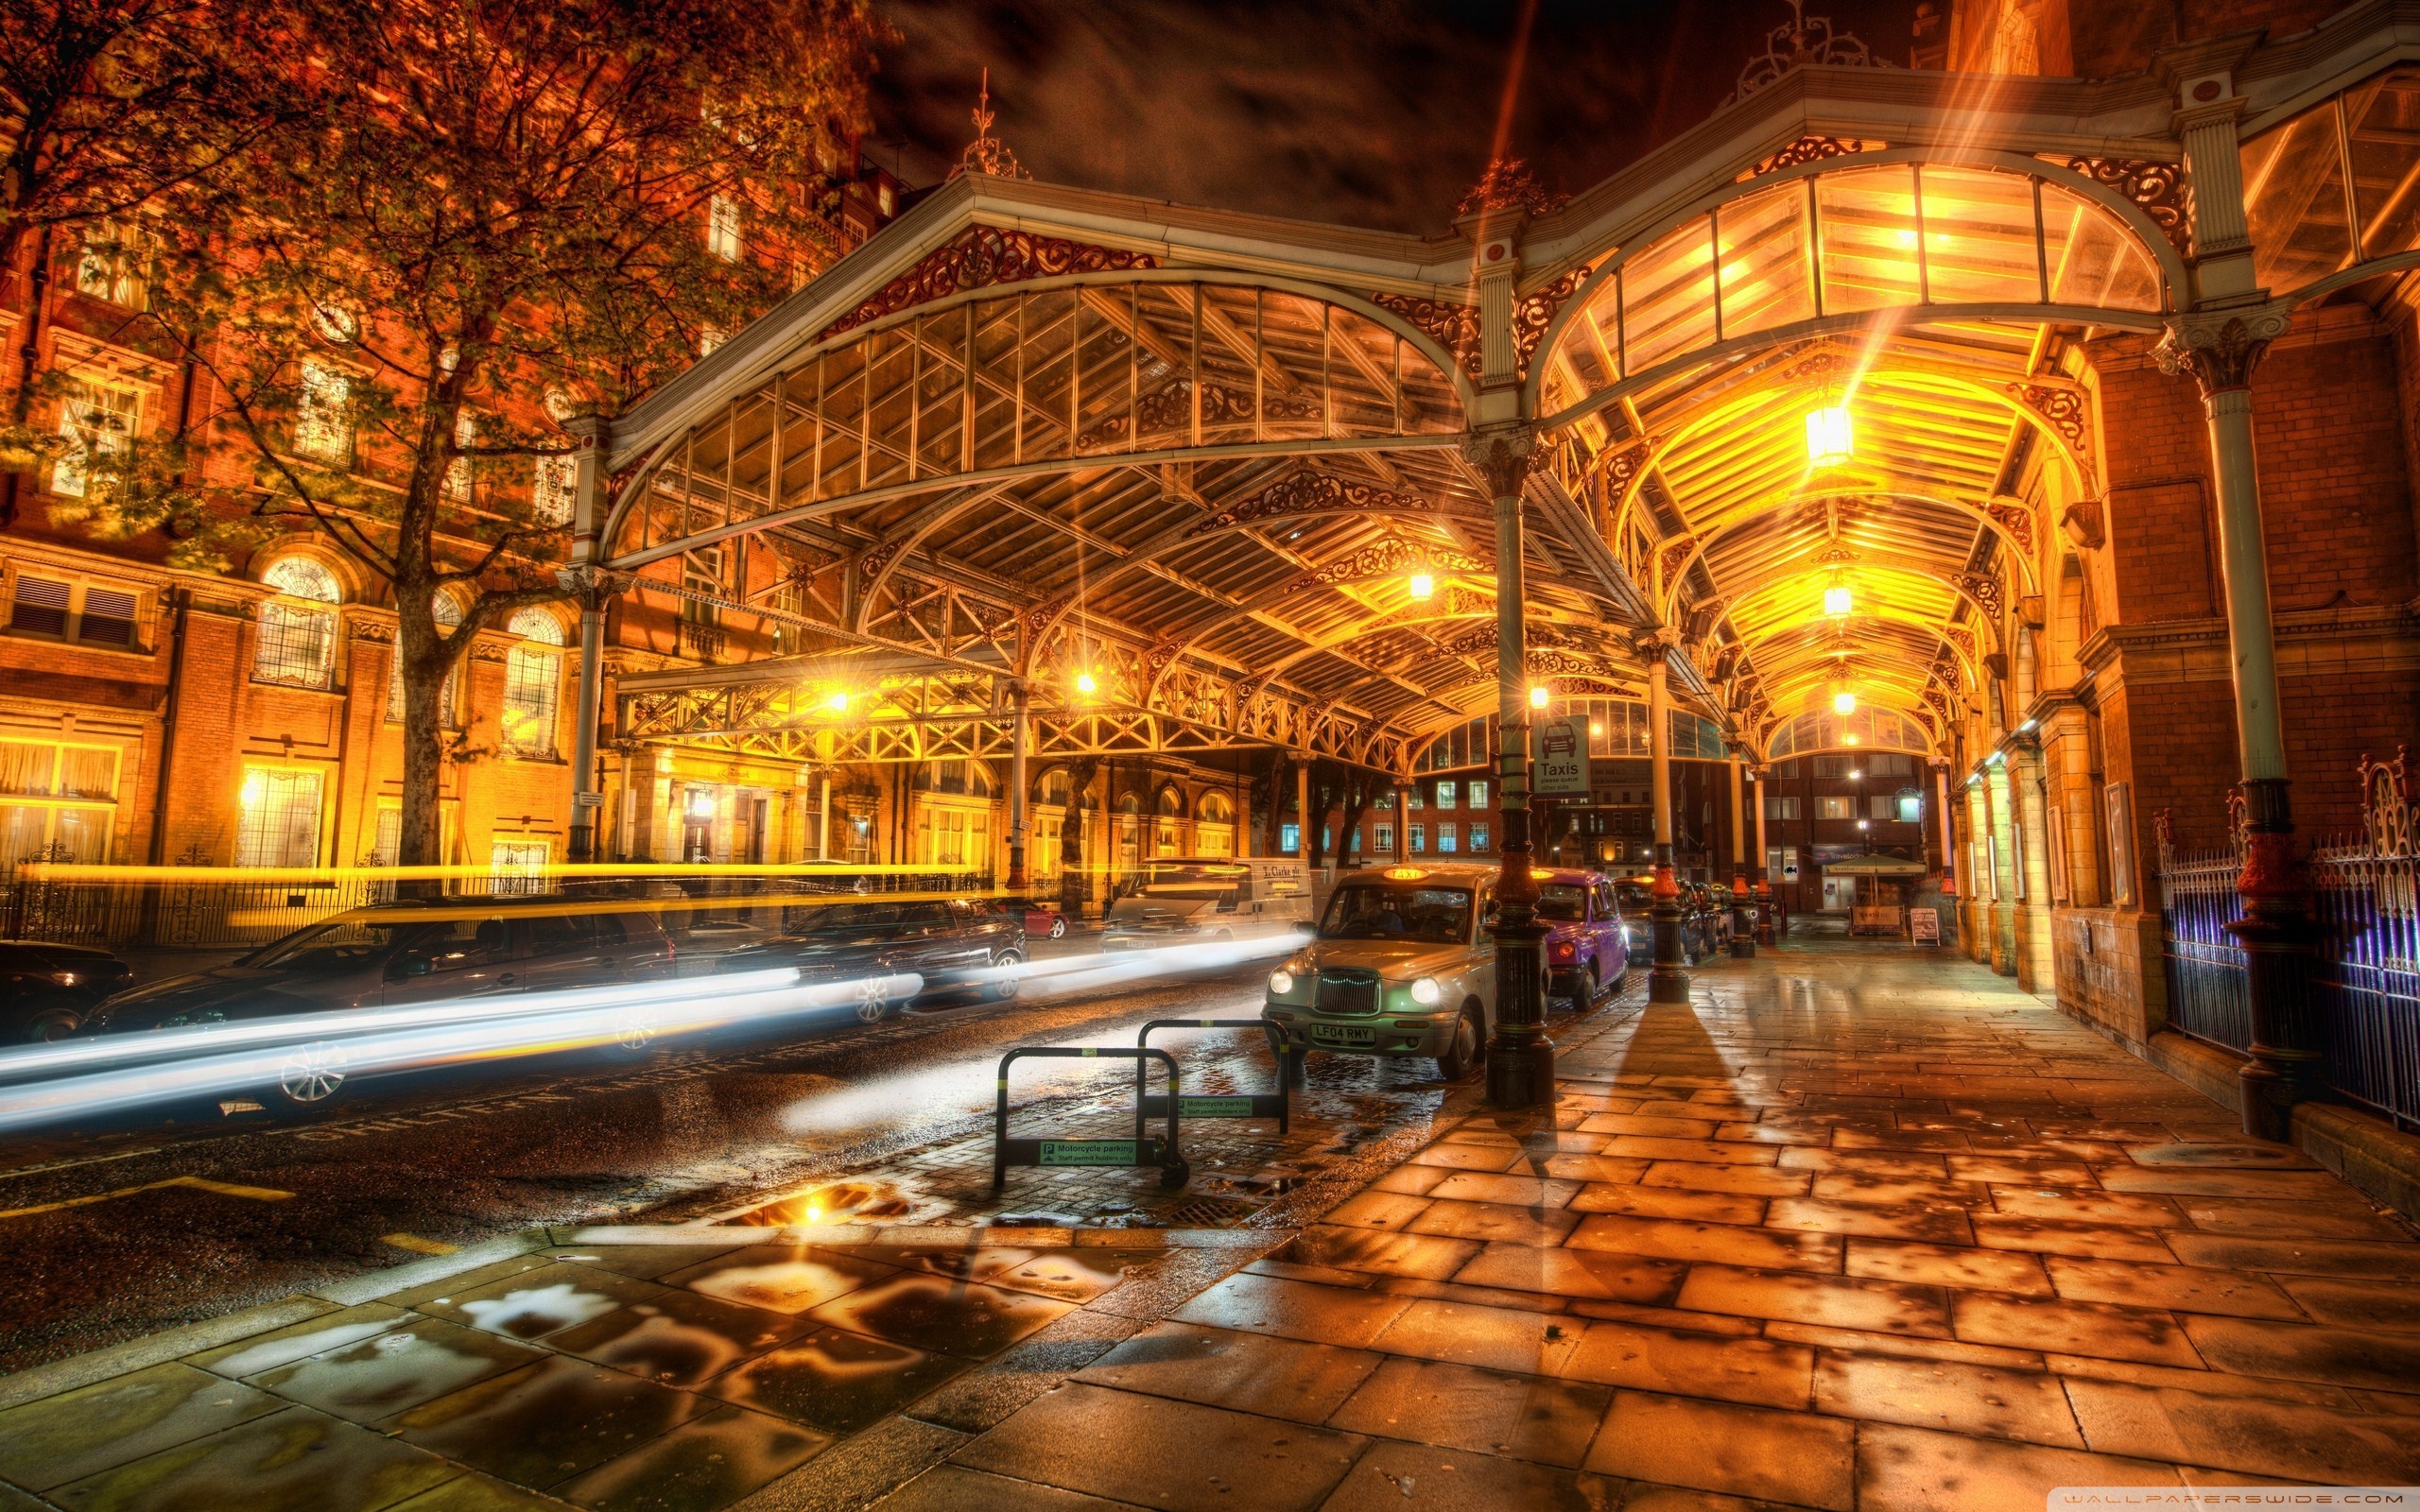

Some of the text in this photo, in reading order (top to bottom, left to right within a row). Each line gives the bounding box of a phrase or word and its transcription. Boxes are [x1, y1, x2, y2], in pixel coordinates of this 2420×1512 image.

[1541, 762, 1579, 776] Taxis
[1263, 866, 1270, 877] T.
[1271, 865, 1290, 877] Clarke
[1391, 869, 1419, 879] TAXI
[1316, 1025, 1369, 1039] LF04 RMY
[1058, 1144, 1101, 1153] Motorcycle
[1103, 1144, 1133, 1153] parking
